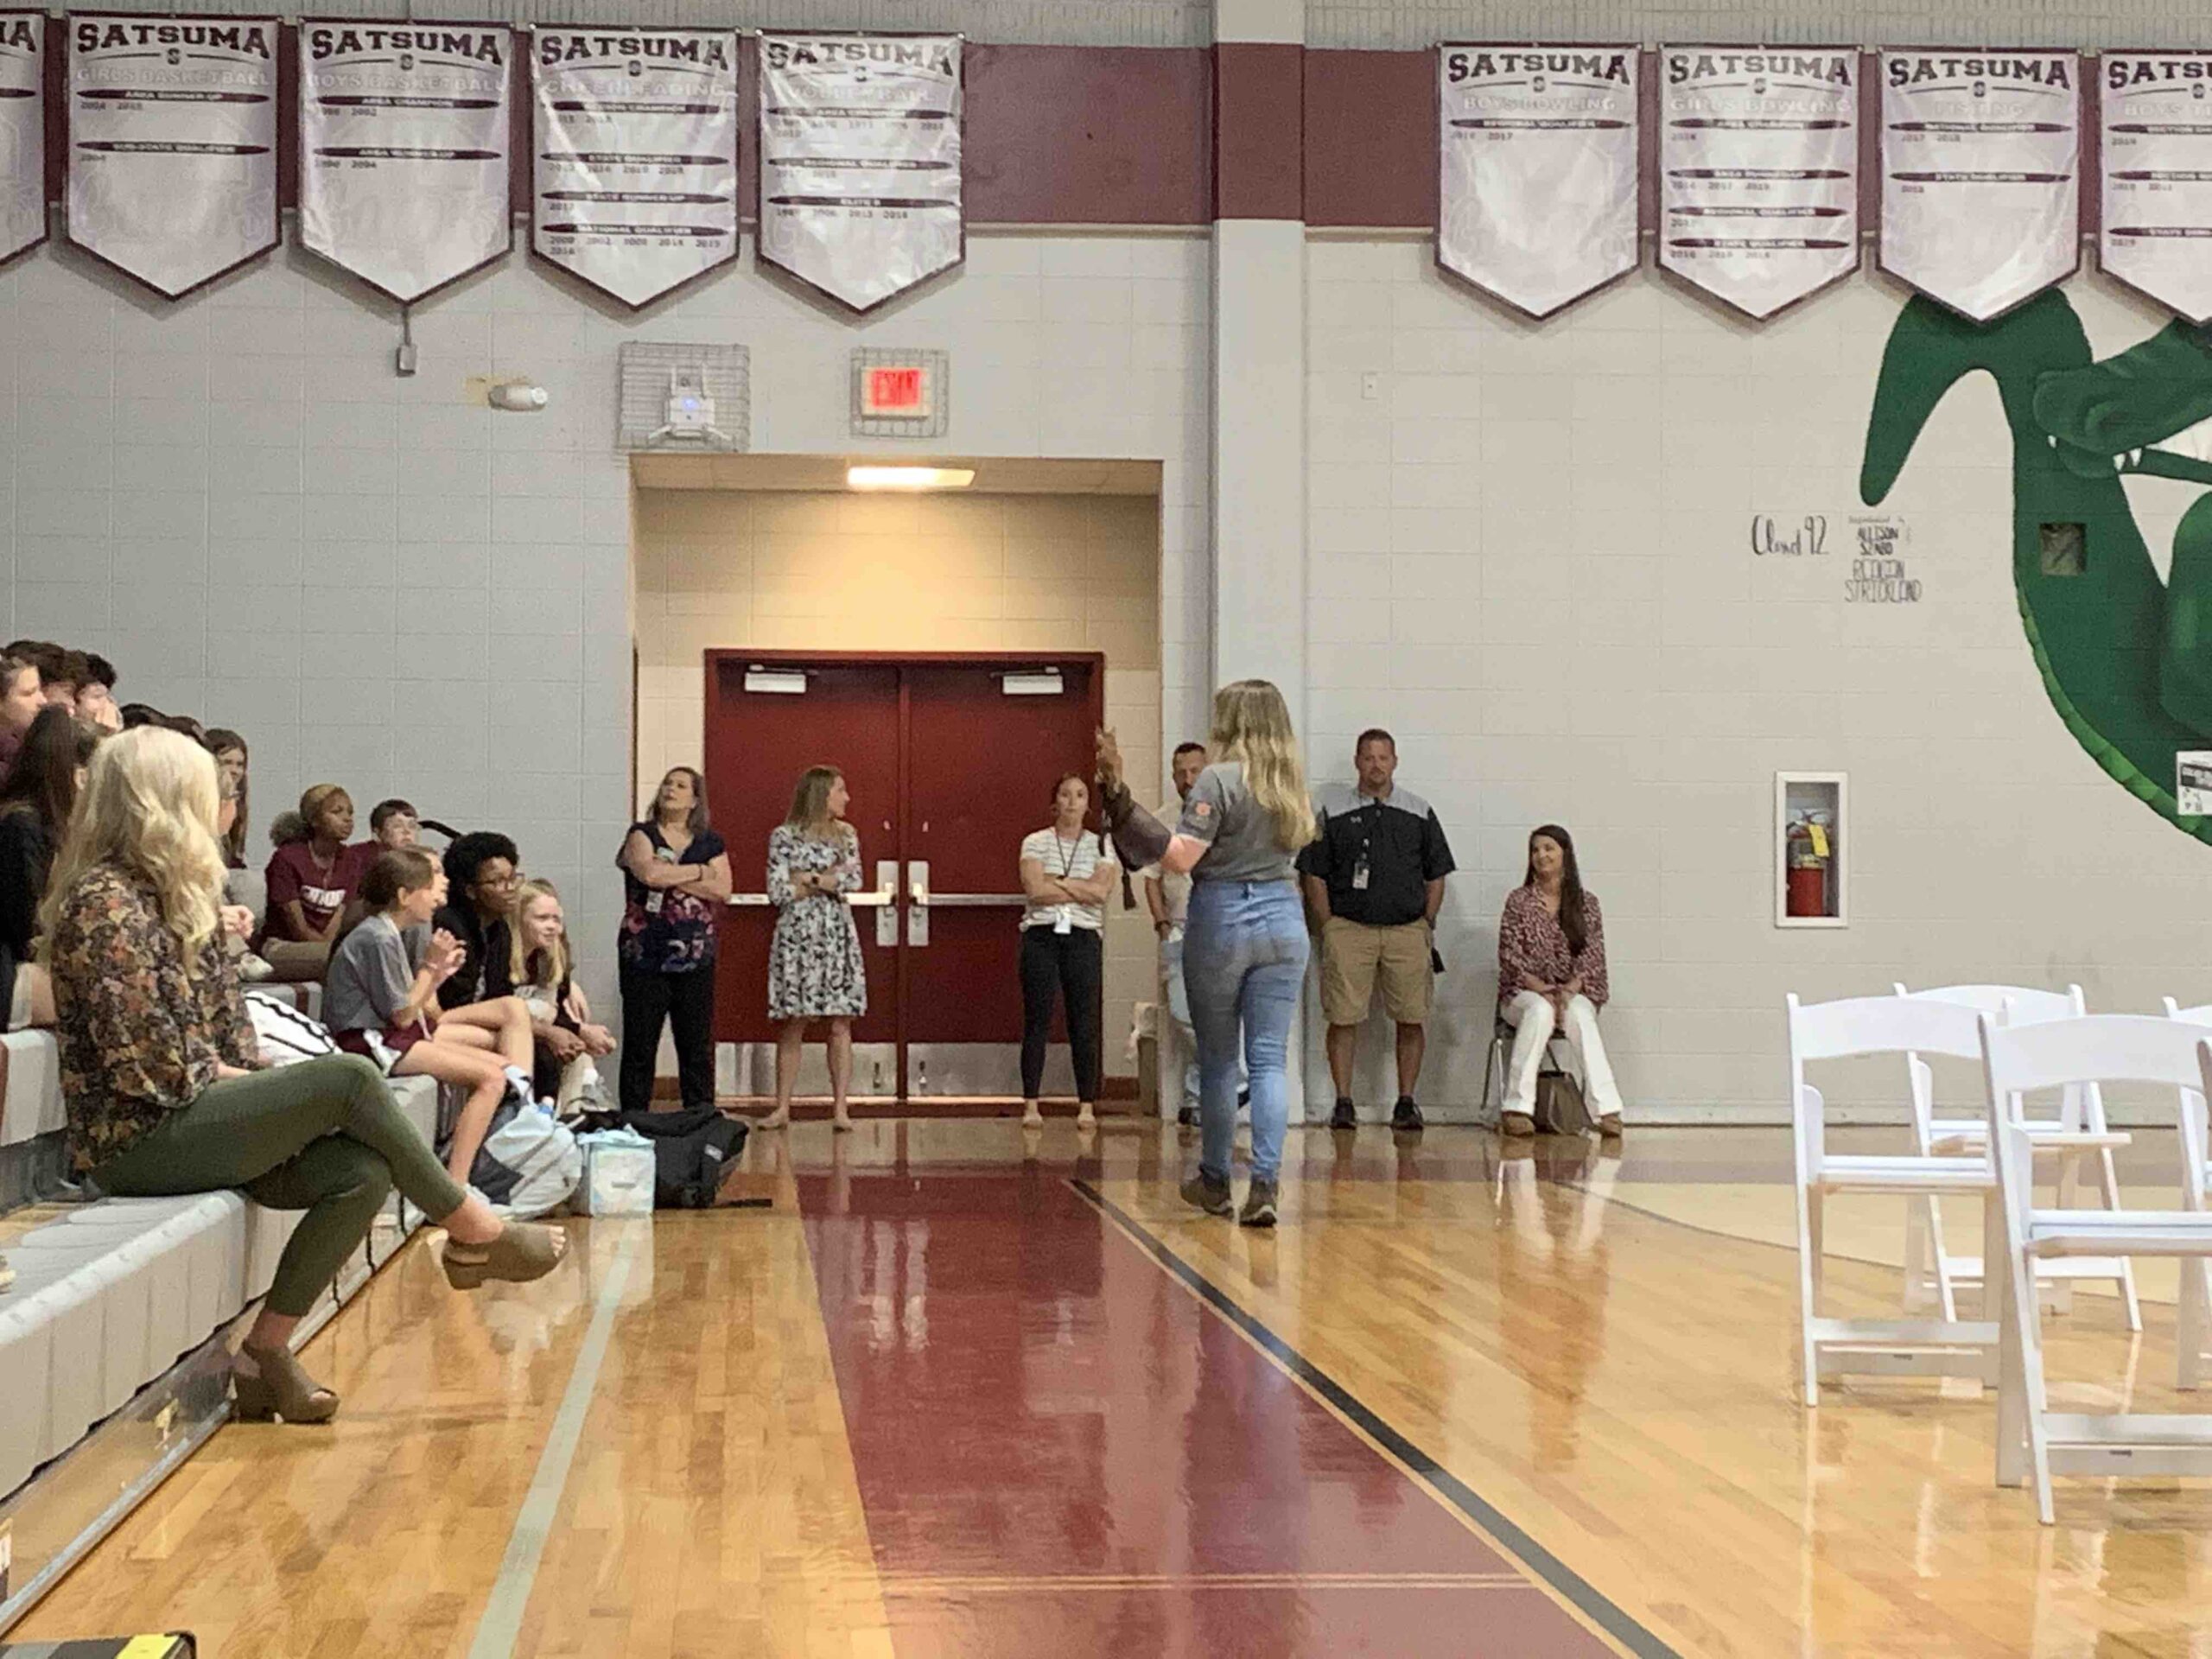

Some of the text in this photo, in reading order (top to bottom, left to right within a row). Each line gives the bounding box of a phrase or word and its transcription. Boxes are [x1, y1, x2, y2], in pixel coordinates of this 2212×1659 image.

[77, 22, 270, 60] SATSUMA
[311, 29, 502, 66] SATSUMA
[541, 35, 728, 71] SATSUMA
[77, 68, 135, 82] GIRLS
[768, 42, 954, 76] SATSUMA
[1448, 54, 1630, 86] SATSUMA
[1669, 54, 1852, 86] SATSUMA
[1889, 59, 2070, 91] SATSUMA
[1464, 97, 1616, 111] BOYS BOWLING
[1670, 99, 1853, 113] GIRLS BOWLING
[1804, 515, 1829, 555] 92
